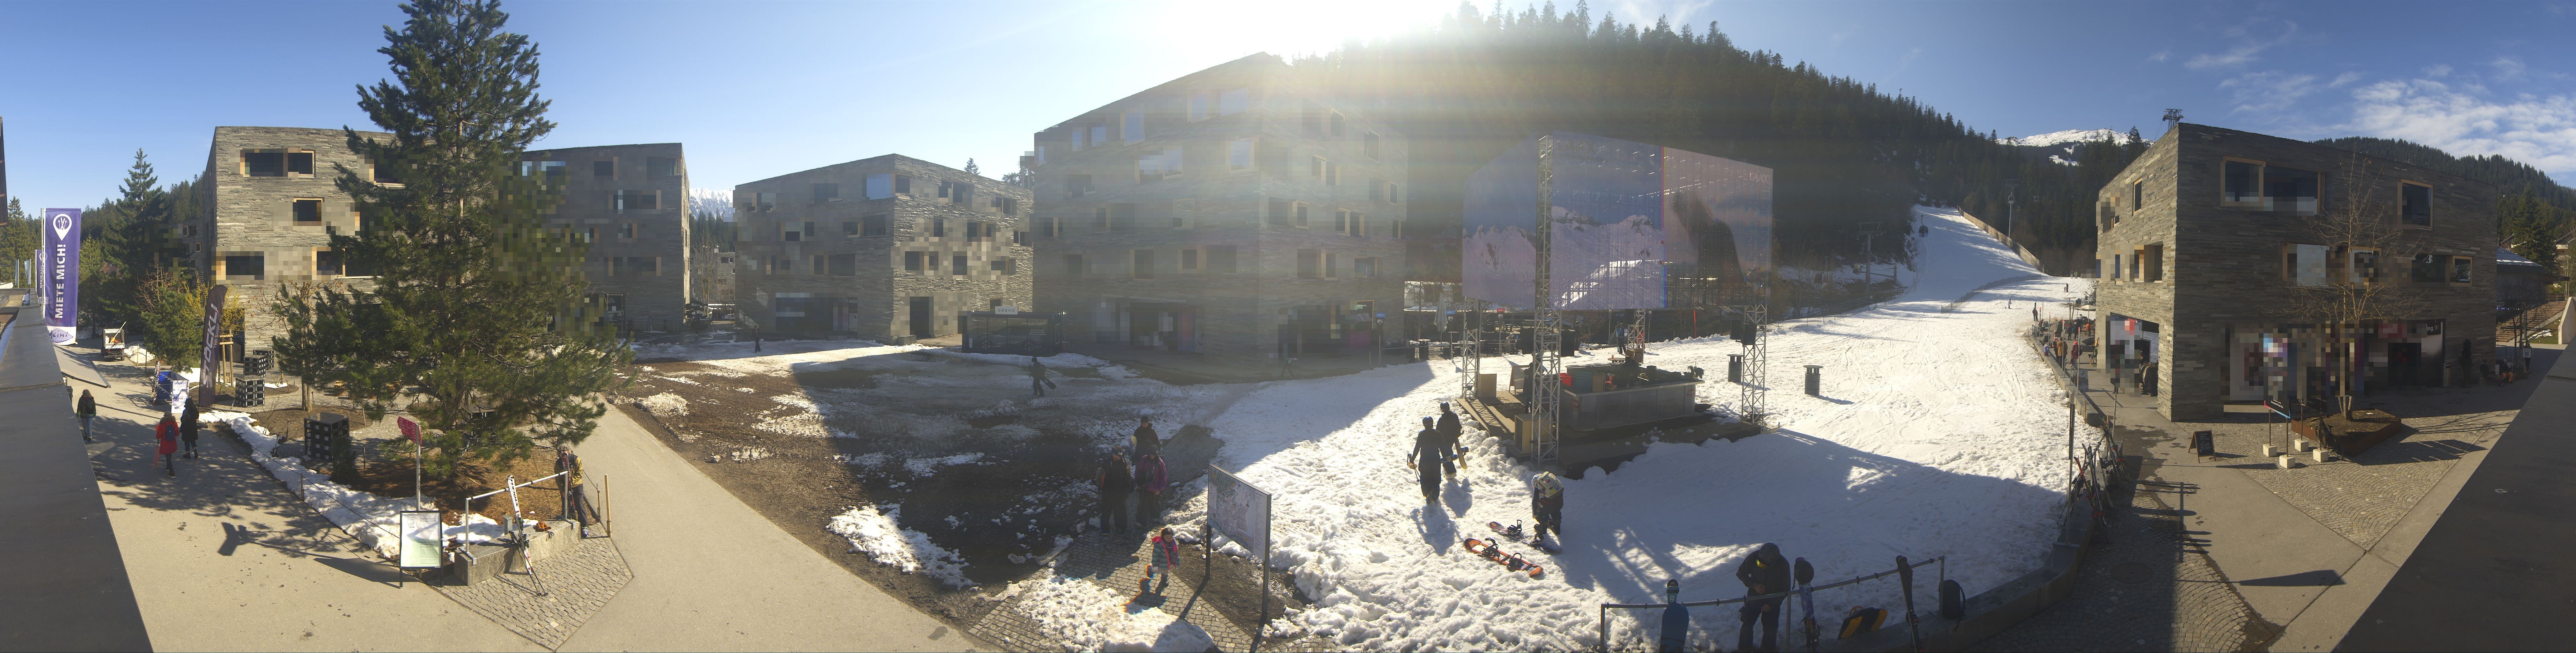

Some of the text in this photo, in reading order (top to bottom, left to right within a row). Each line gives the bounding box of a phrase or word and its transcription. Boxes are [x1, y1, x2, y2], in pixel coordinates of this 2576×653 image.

[1750, 172, 1769, 184] LAAX
[55, 244, 66, 318] MIETE MICH!
[203, 303, 218, 388] STÖCKLI
